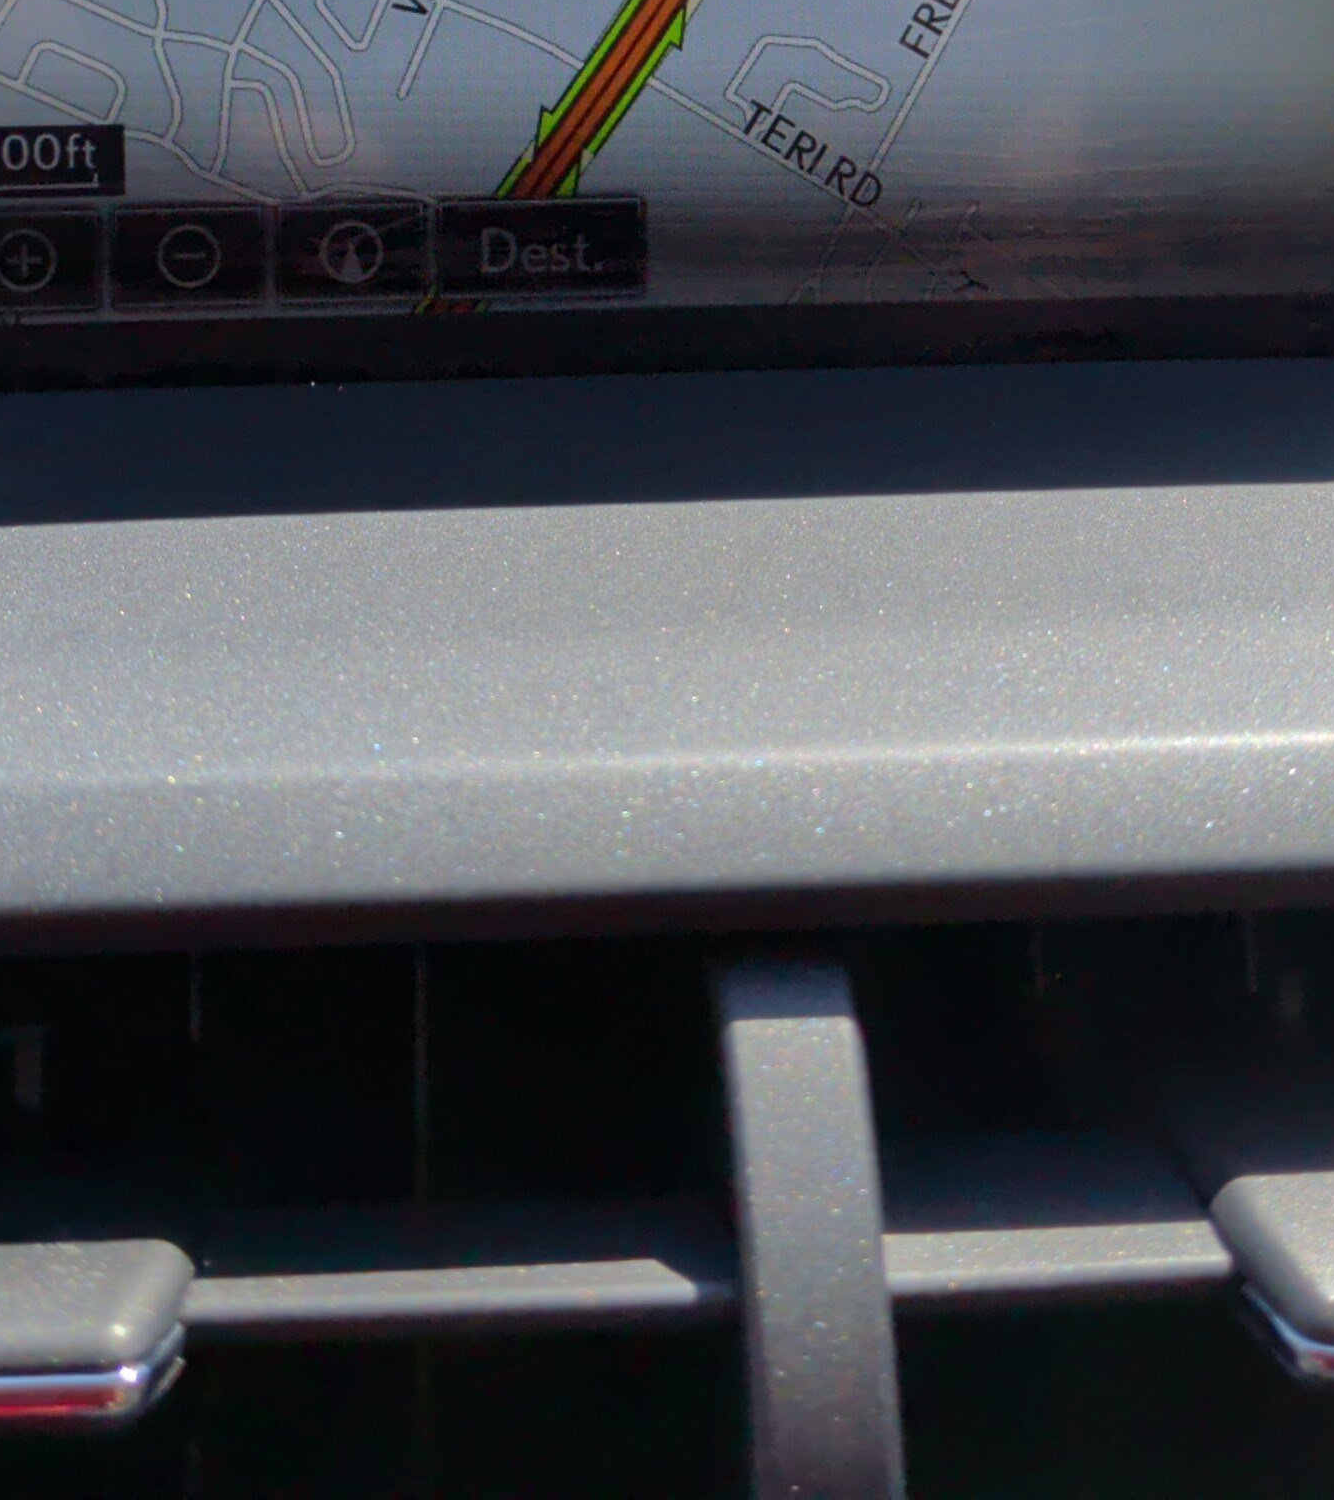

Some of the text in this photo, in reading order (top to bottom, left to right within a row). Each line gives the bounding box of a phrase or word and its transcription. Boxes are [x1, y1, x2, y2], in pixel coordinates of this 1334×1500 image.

[743, 99, 883, 207] TERI RD
[480, 227, 603, 274] Dest.
